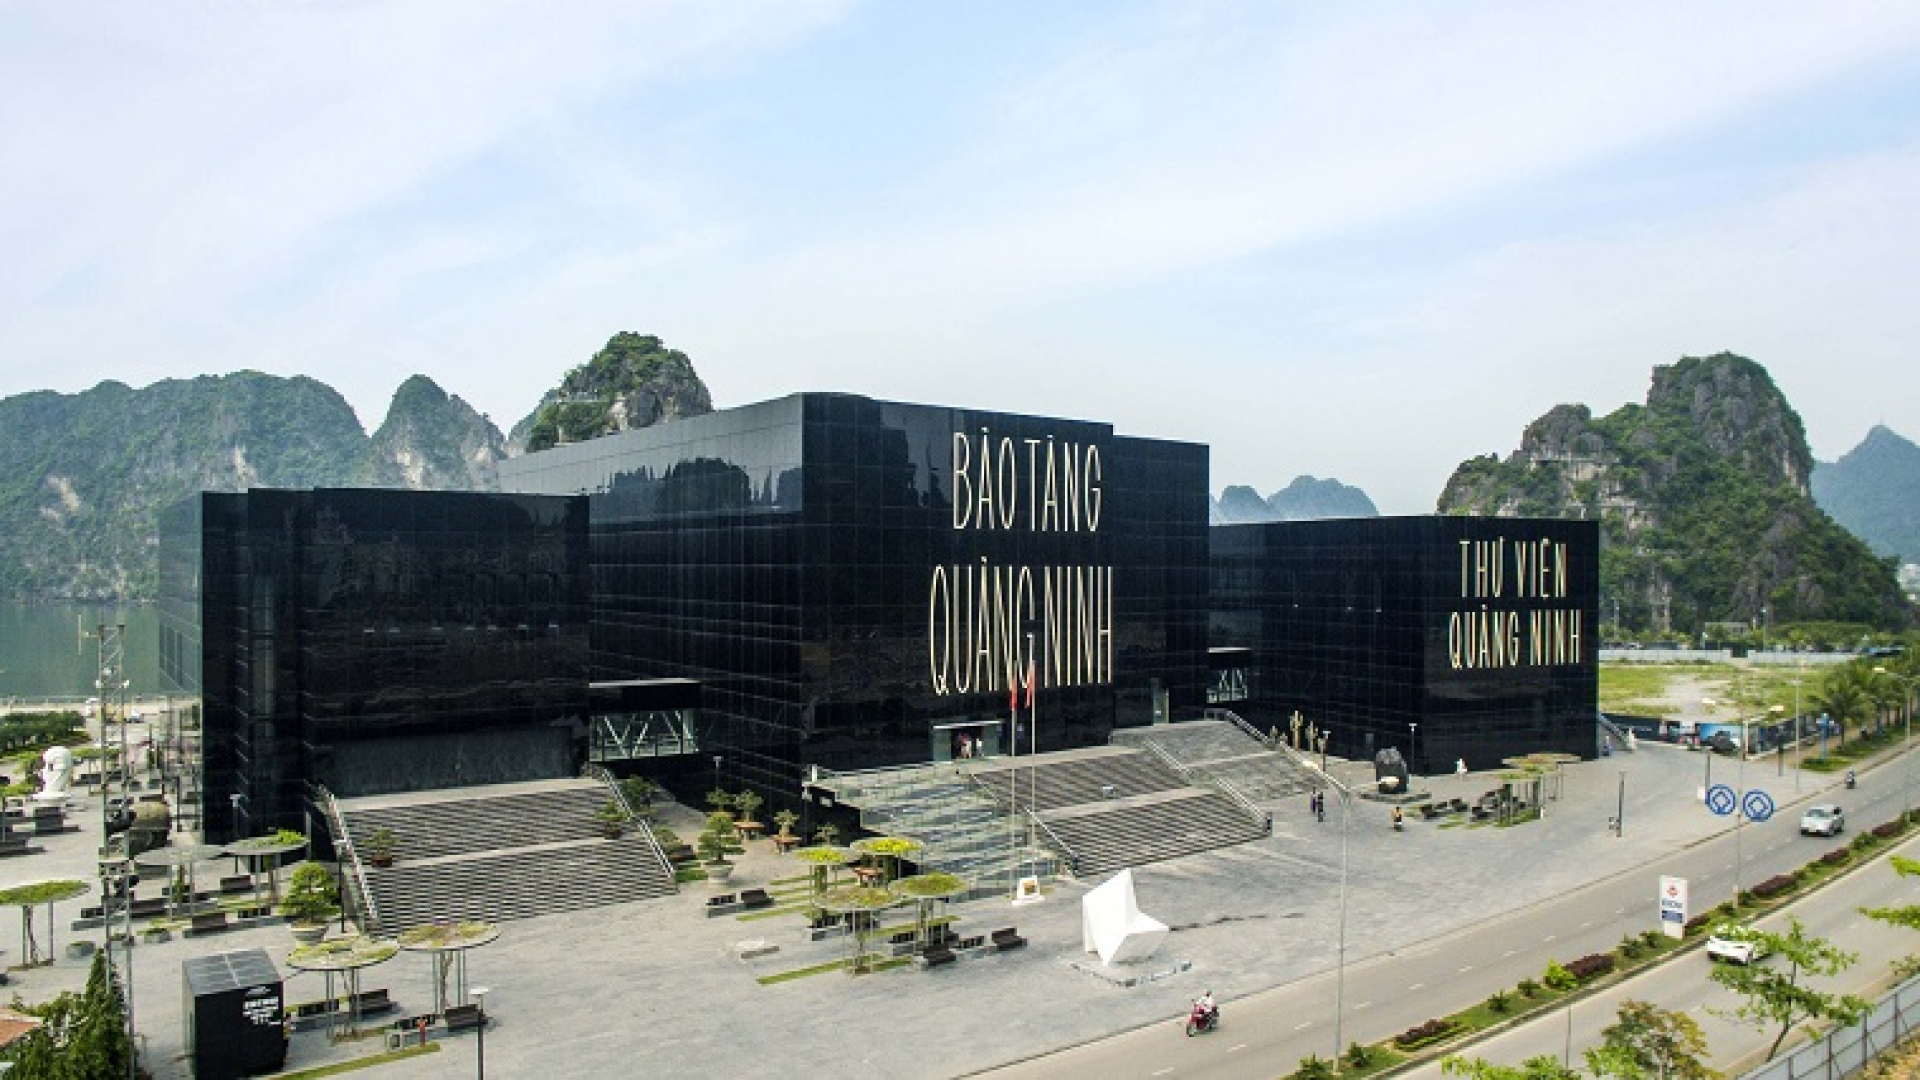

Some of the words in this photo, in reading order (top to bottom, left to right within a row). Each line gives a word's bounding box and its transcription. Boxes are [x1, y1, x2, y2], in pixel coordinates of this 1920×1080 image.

[953, 427, 1017, 530] BẢO
[1024, 435, 1101, 531] TÀNG
[930, 556, 1035, 696] QUẢNG
[1045, 566, 1113, 689] NINH
[1449, 604, 1520, 670] QUẢNG
[1530, 609, 1582, 666] NINH
